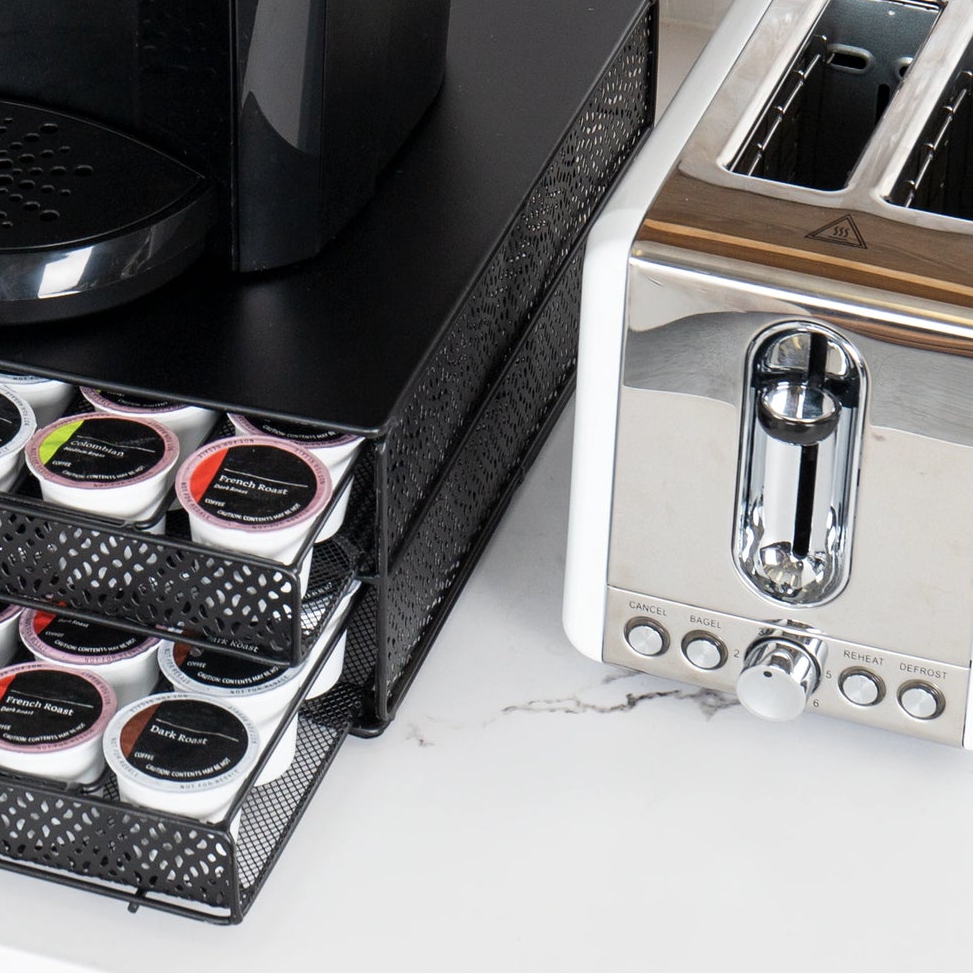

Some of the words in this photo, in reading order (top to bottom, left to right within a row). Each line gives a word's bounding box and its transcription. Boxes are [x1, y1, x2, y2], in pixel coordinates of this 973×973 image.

[70, 440, 125, 458] Colombian
[219, 475, 256, 489] French
[257, 483, 289, 496] Roast
[204, 498, 226, 507] COFFEE
[629, 601, 667, 616] CANCEL
[690, 615, 721, 628] BAGEL
[734, 650, 739, 658] 2
[843, 650, 884, 666] REHEAT
[826, 670, 831, 679] 5
[899, 662, 947, 679] DEFROST
[6, 696, 43, 708] French
[43, 702, 75, 716] Roast
[813, 699, 819, 707] 6
[150, 725, 177, 740] Dark
[177, 733, 208, 745] Roast
